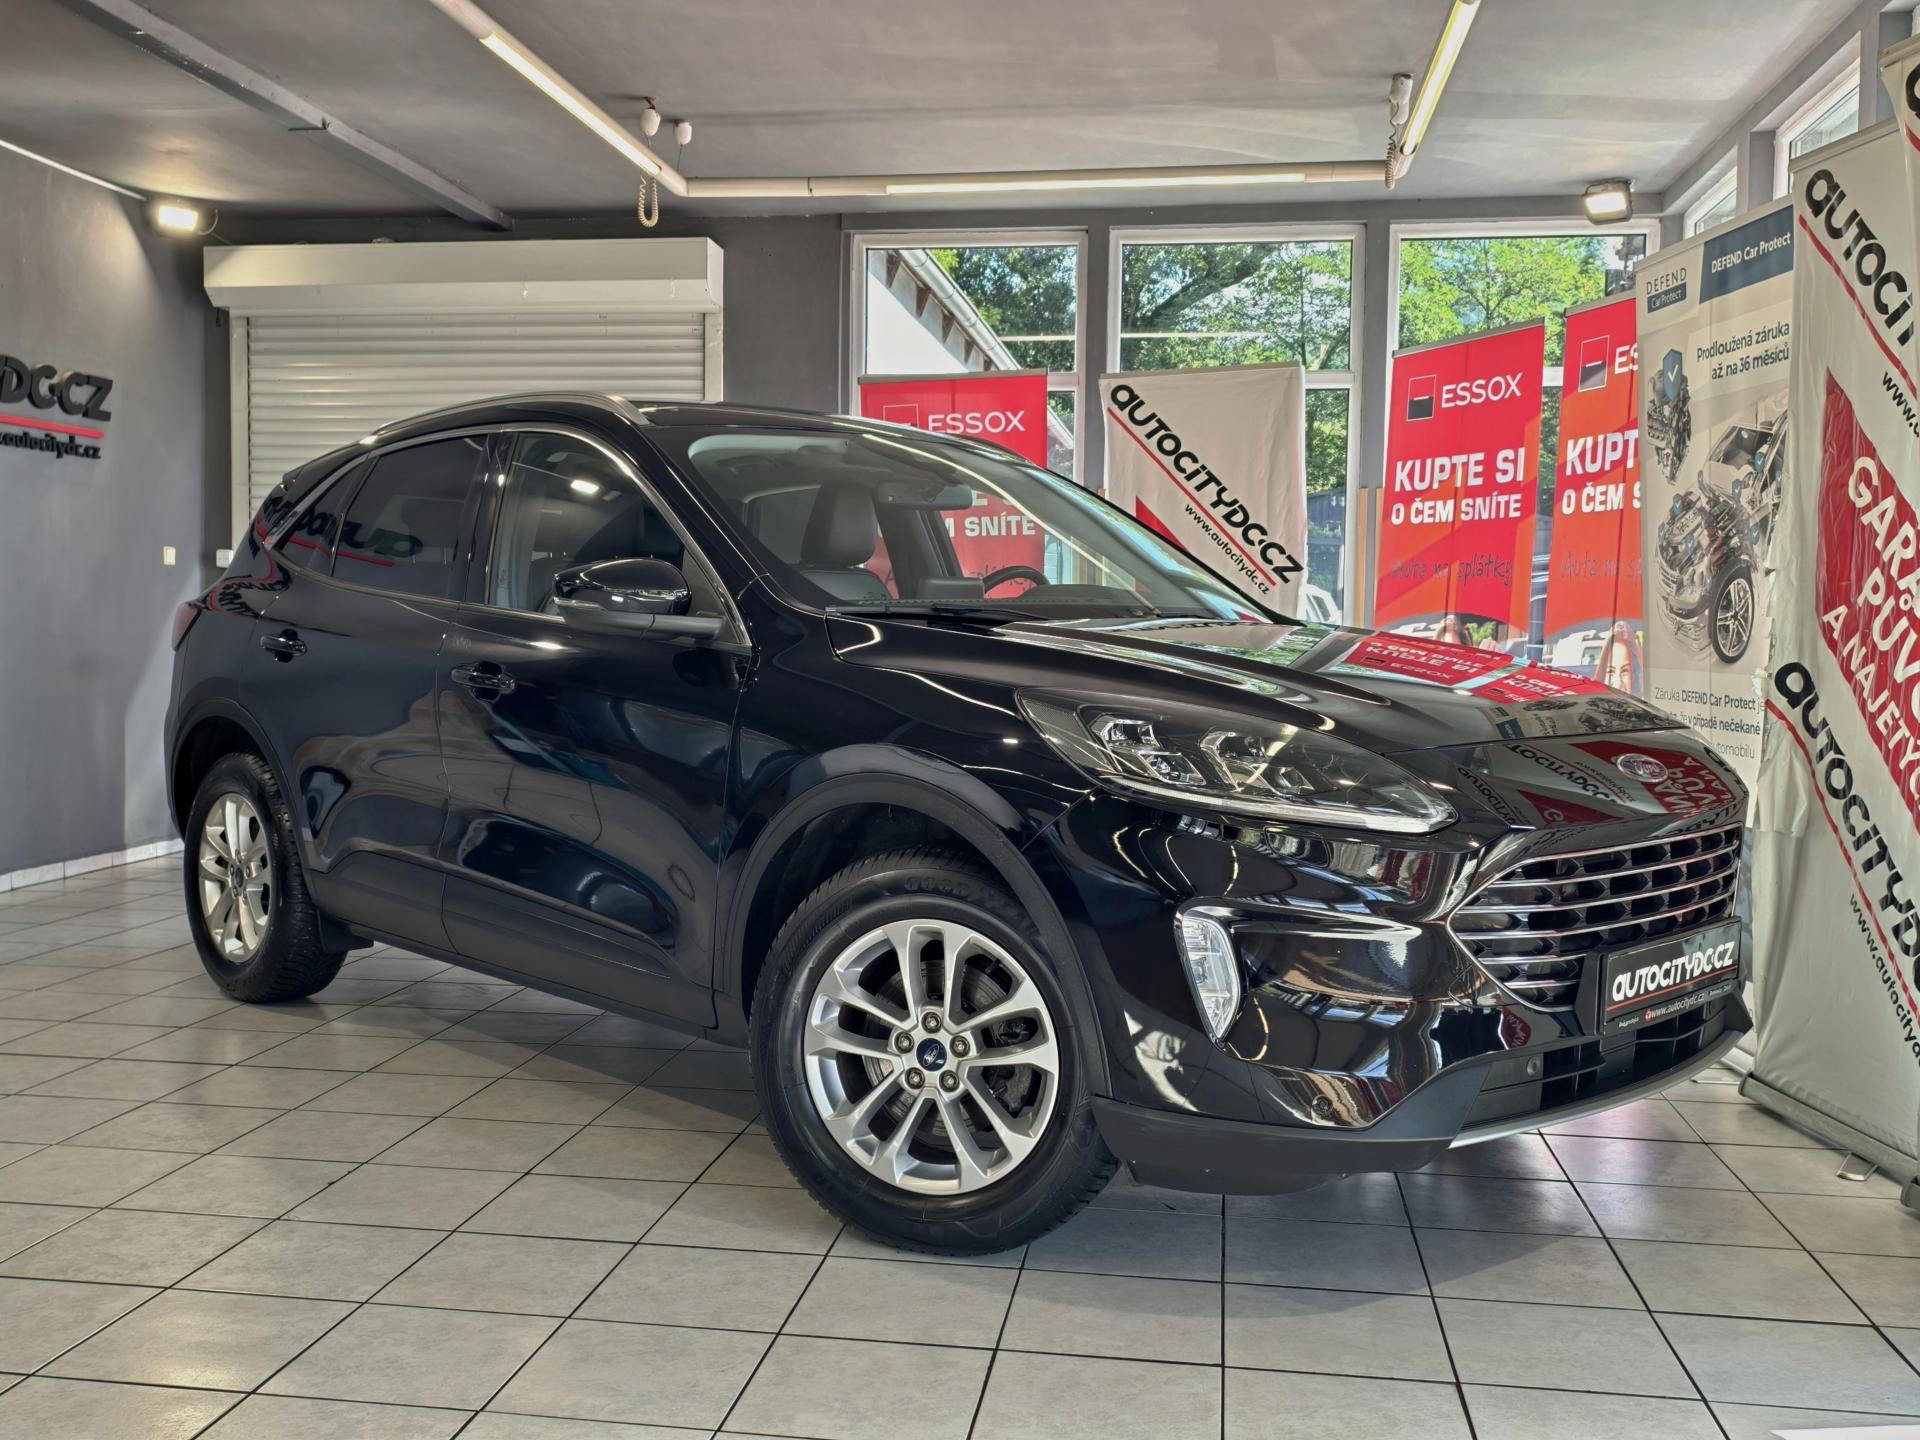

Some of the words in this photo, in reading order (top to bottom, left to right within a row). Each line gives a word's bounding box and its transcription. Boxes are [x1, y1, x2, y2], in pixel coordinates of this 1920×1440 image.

[1711, 249, 1742, 273] DEFEND
[1743, 246, 1758, 260] Car
[1759, 232, 1791, 255] Protect
[1646, 267, 1687, 295] DEFEND
[1697, 330, 1753, 362] Prodloužená
[1755, 321, 1790, 345] záruka
[1711, 362, 1724, 380] až
[1726, 362, 1738, 377] na
[1739, 355, 1750, 373] 36
[1752, 341, 1789, 369] měsíců
[1441, 372, 1523, 409] ESSOX
[927, 410, 1026, 434] ESSOX
[1394, 452, 1485, 492] KUPTE
[1495, 447, 1526, 484] SI
[1391, 502, 1405, 525] O
[1410, 498, 1454, 524] ČEM
[1460, 491, 1522, 521] SNÍTE
[1561, 488, 1576, 515] O
[1581, 481, 1625, 513] ČEM
[964, 511, 1036, 537] SNÍTE
[1185, 504, 1270, 594] www.autocitydc.cz
[1822, 604, 1848, 640] A
[1655, 686, 1680, 702] Záruka
[1681, 689, 1708, 705] DEFEND
[1709, 693, 1722, 707] Car
[1724, 695, 1756, 710] Protect
[1719, 719, 1760, 735] nečekané
